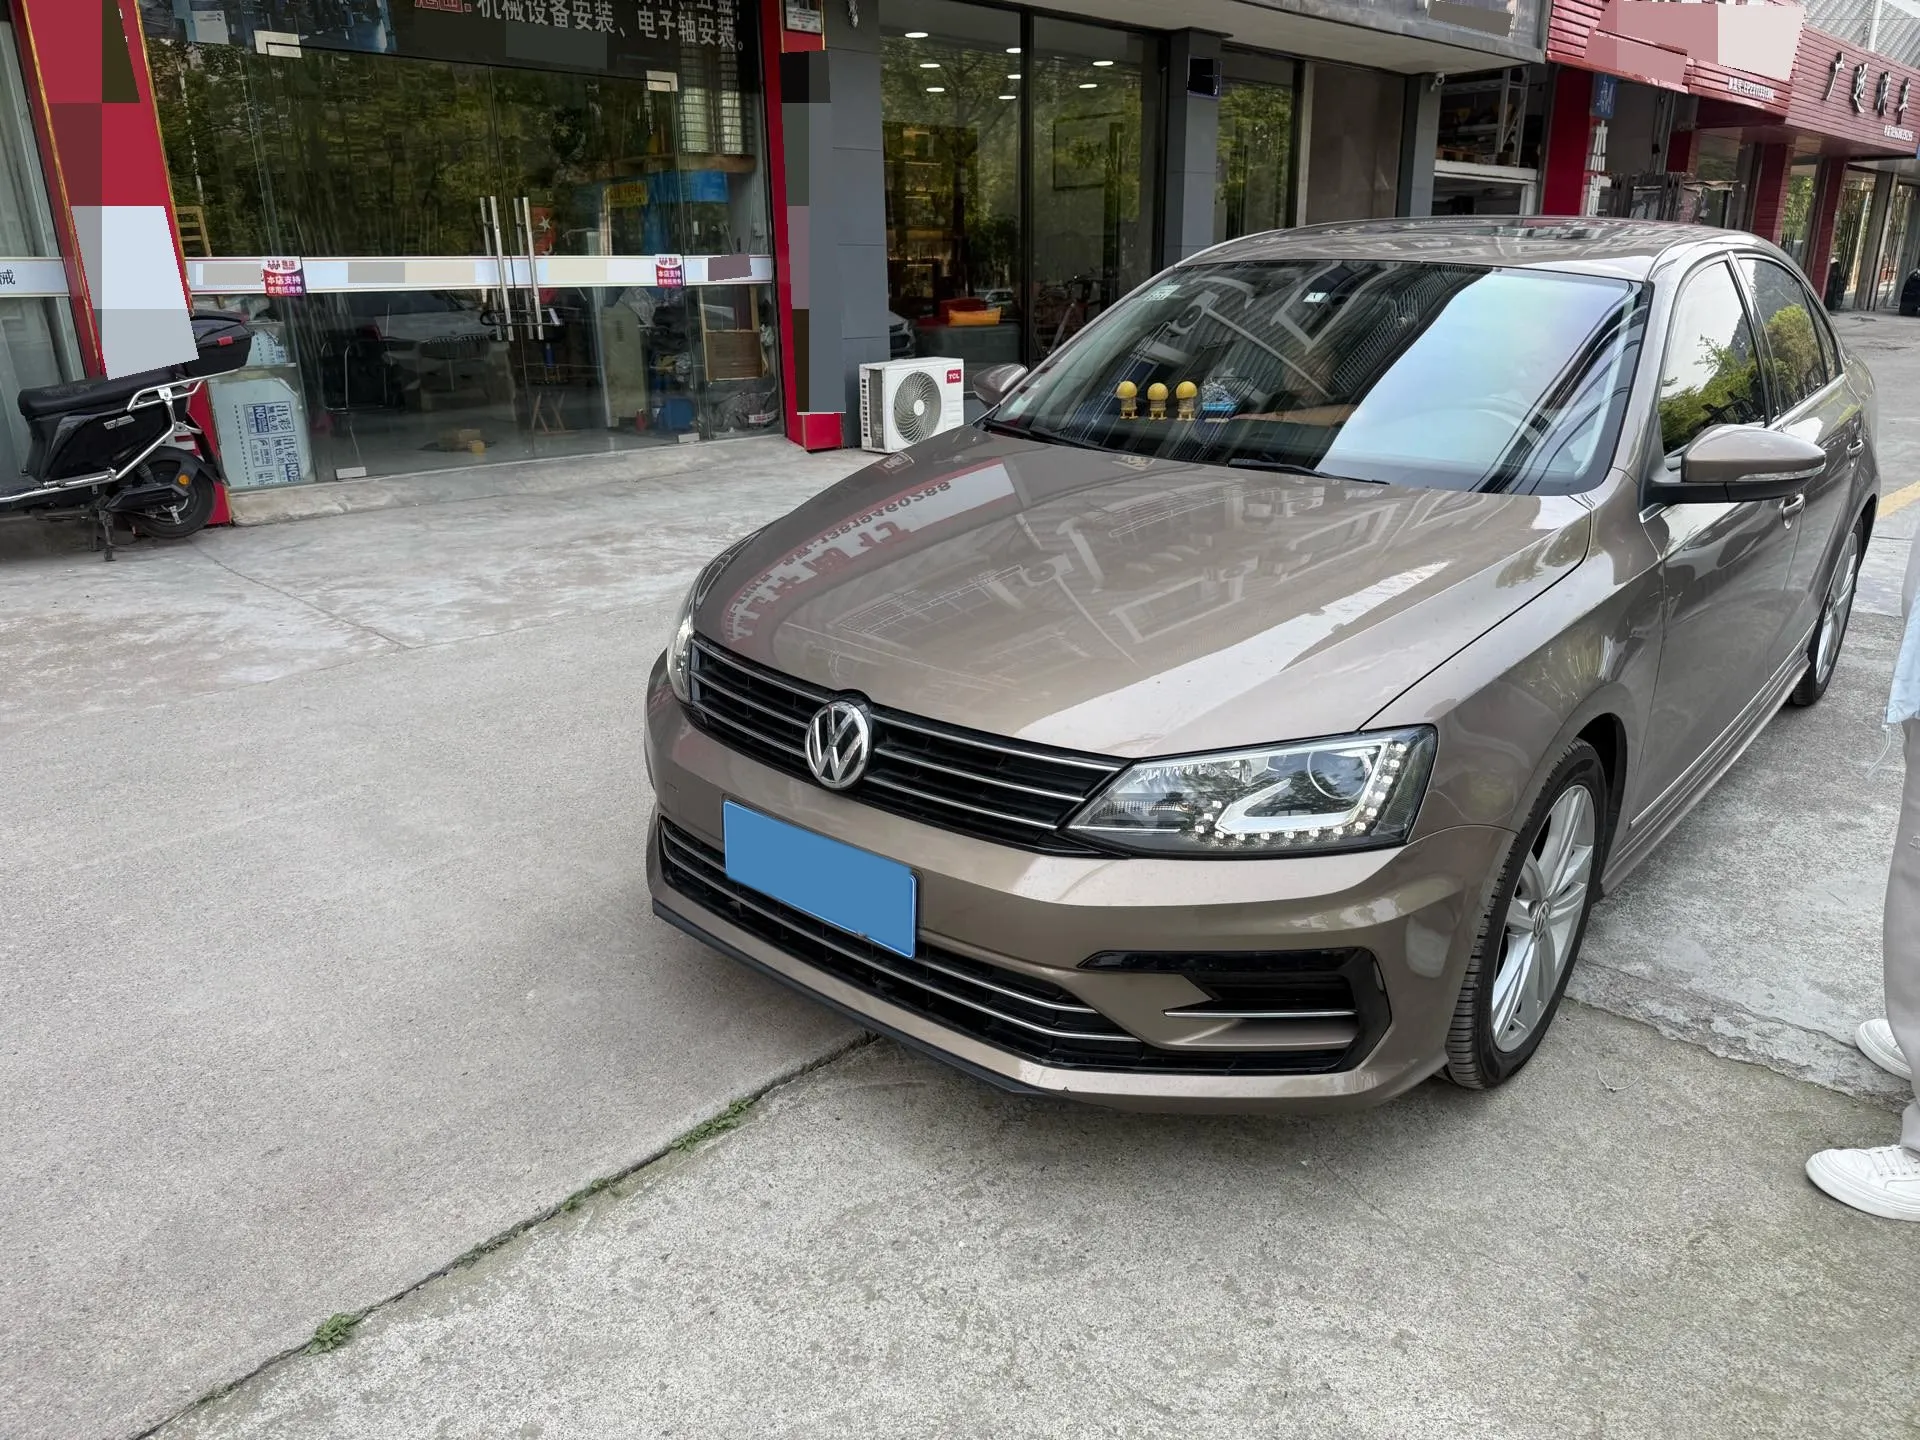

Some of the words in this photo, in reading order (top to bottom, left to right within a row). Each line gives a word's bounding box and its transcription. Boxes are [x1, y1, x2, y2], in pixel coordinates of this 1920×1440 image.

[266, 275, 302, 285] 本店支持
[947, 372, 960, 380] TCL
